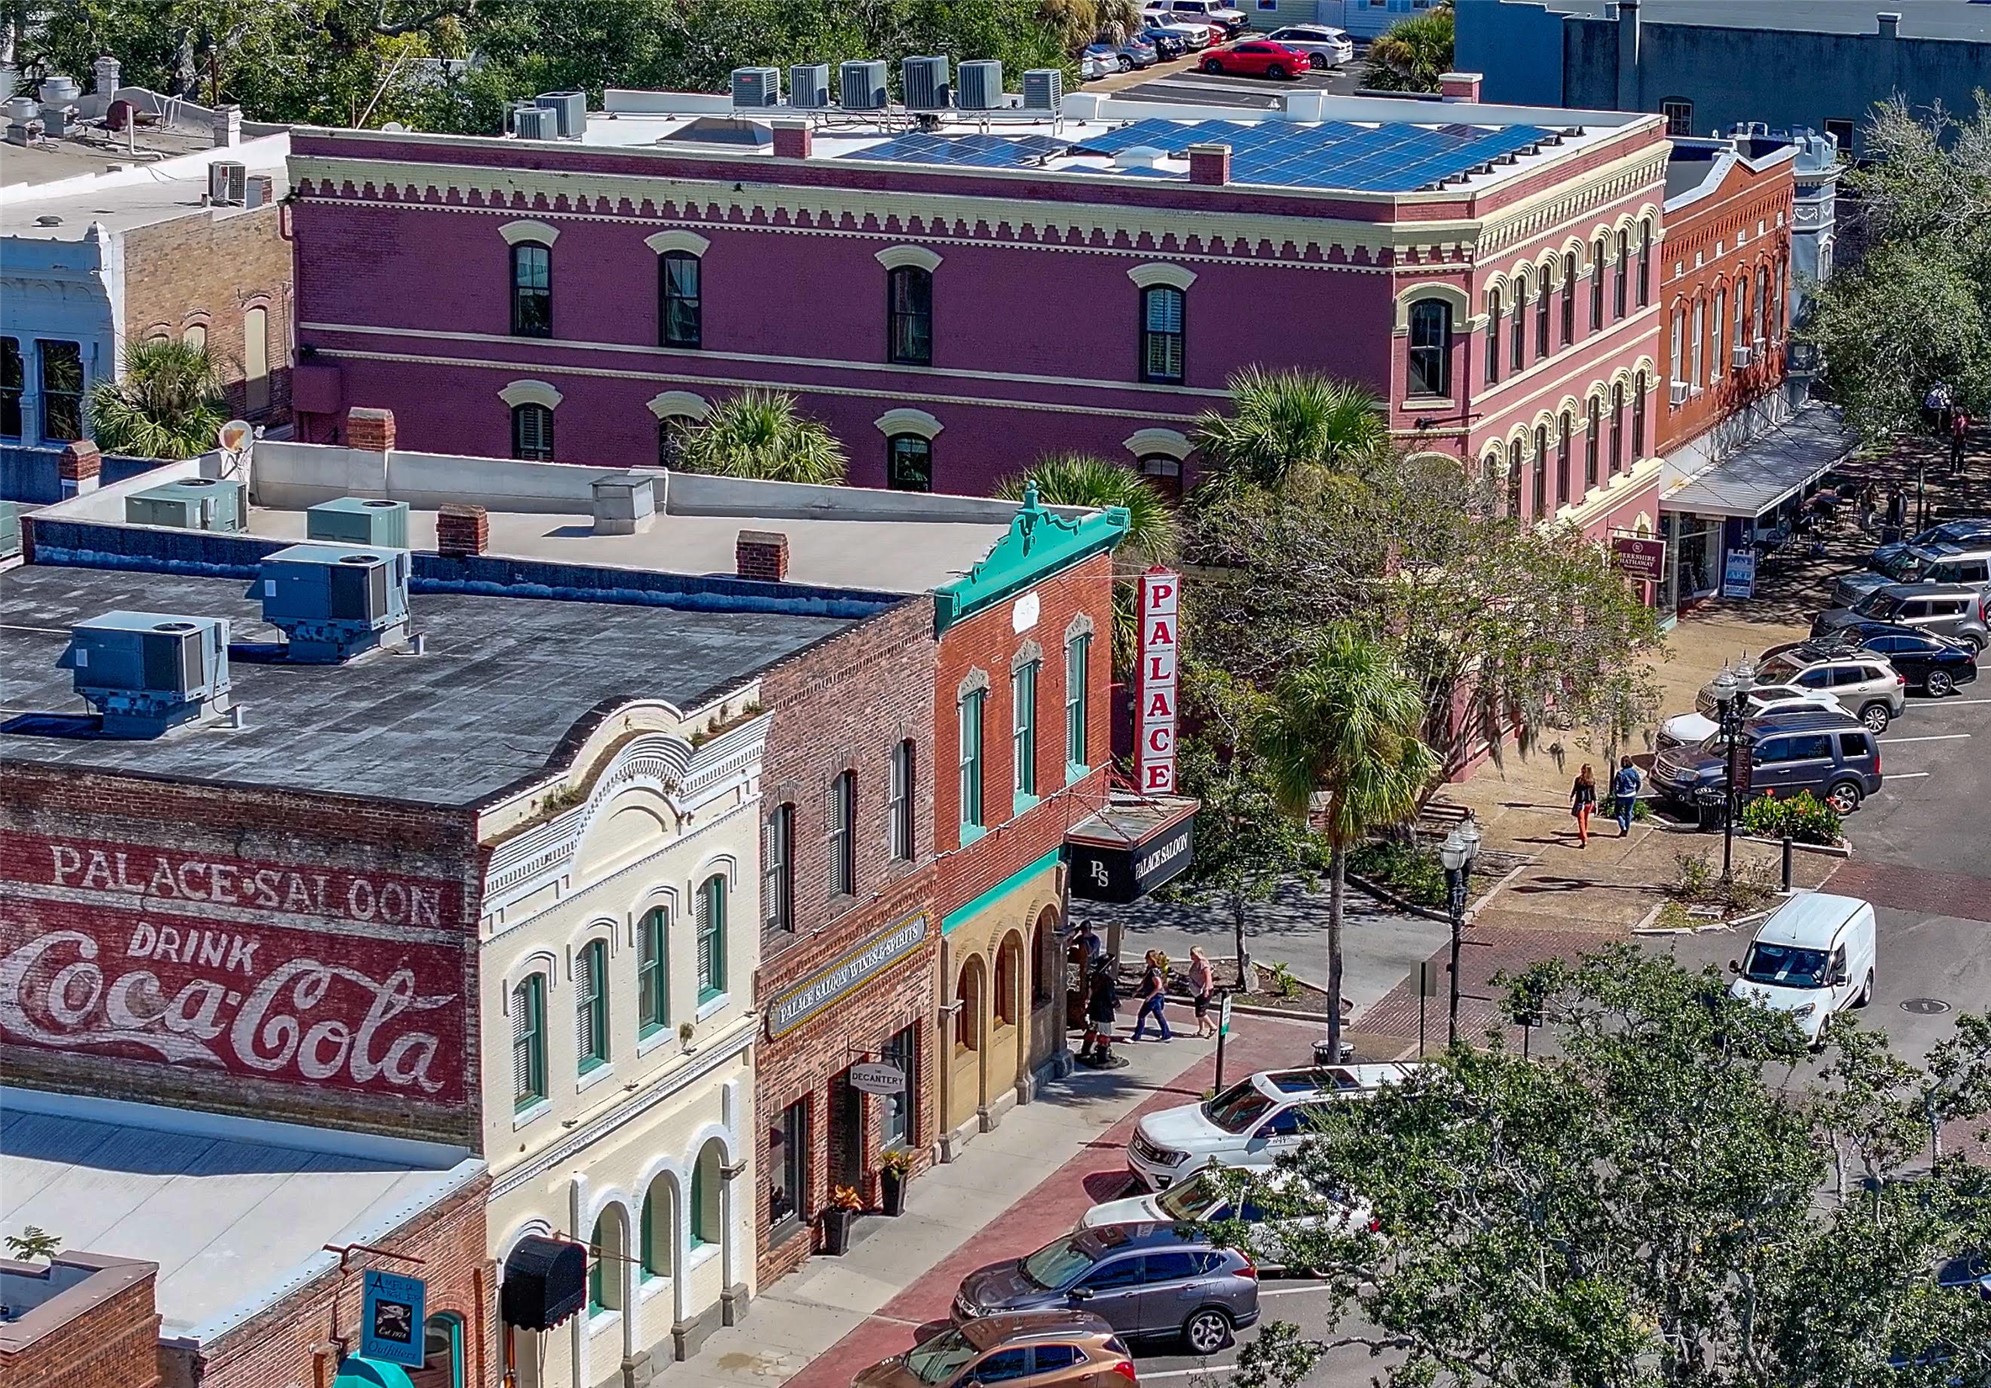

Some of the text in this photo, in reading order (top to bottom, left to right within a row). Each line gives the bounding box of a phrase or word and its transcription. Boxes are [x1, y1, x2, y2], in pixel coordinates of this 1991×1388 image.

[1728, 571, 1750, 580] ART
[1147, 584, 1174, 789] PALACE
[1135, 832, 1188, 880] PALACE SALOON
[50, 845, 442, 927] PALACE SALOON
[127, 921, 260, 975] DRINK
[780, 923, 918, 1023] PALACE SALOON WINES & SPIRITS
[852, 1073, 904, 1086] DECANTERY
[368, 1341, 416, 1359] Outfitters
